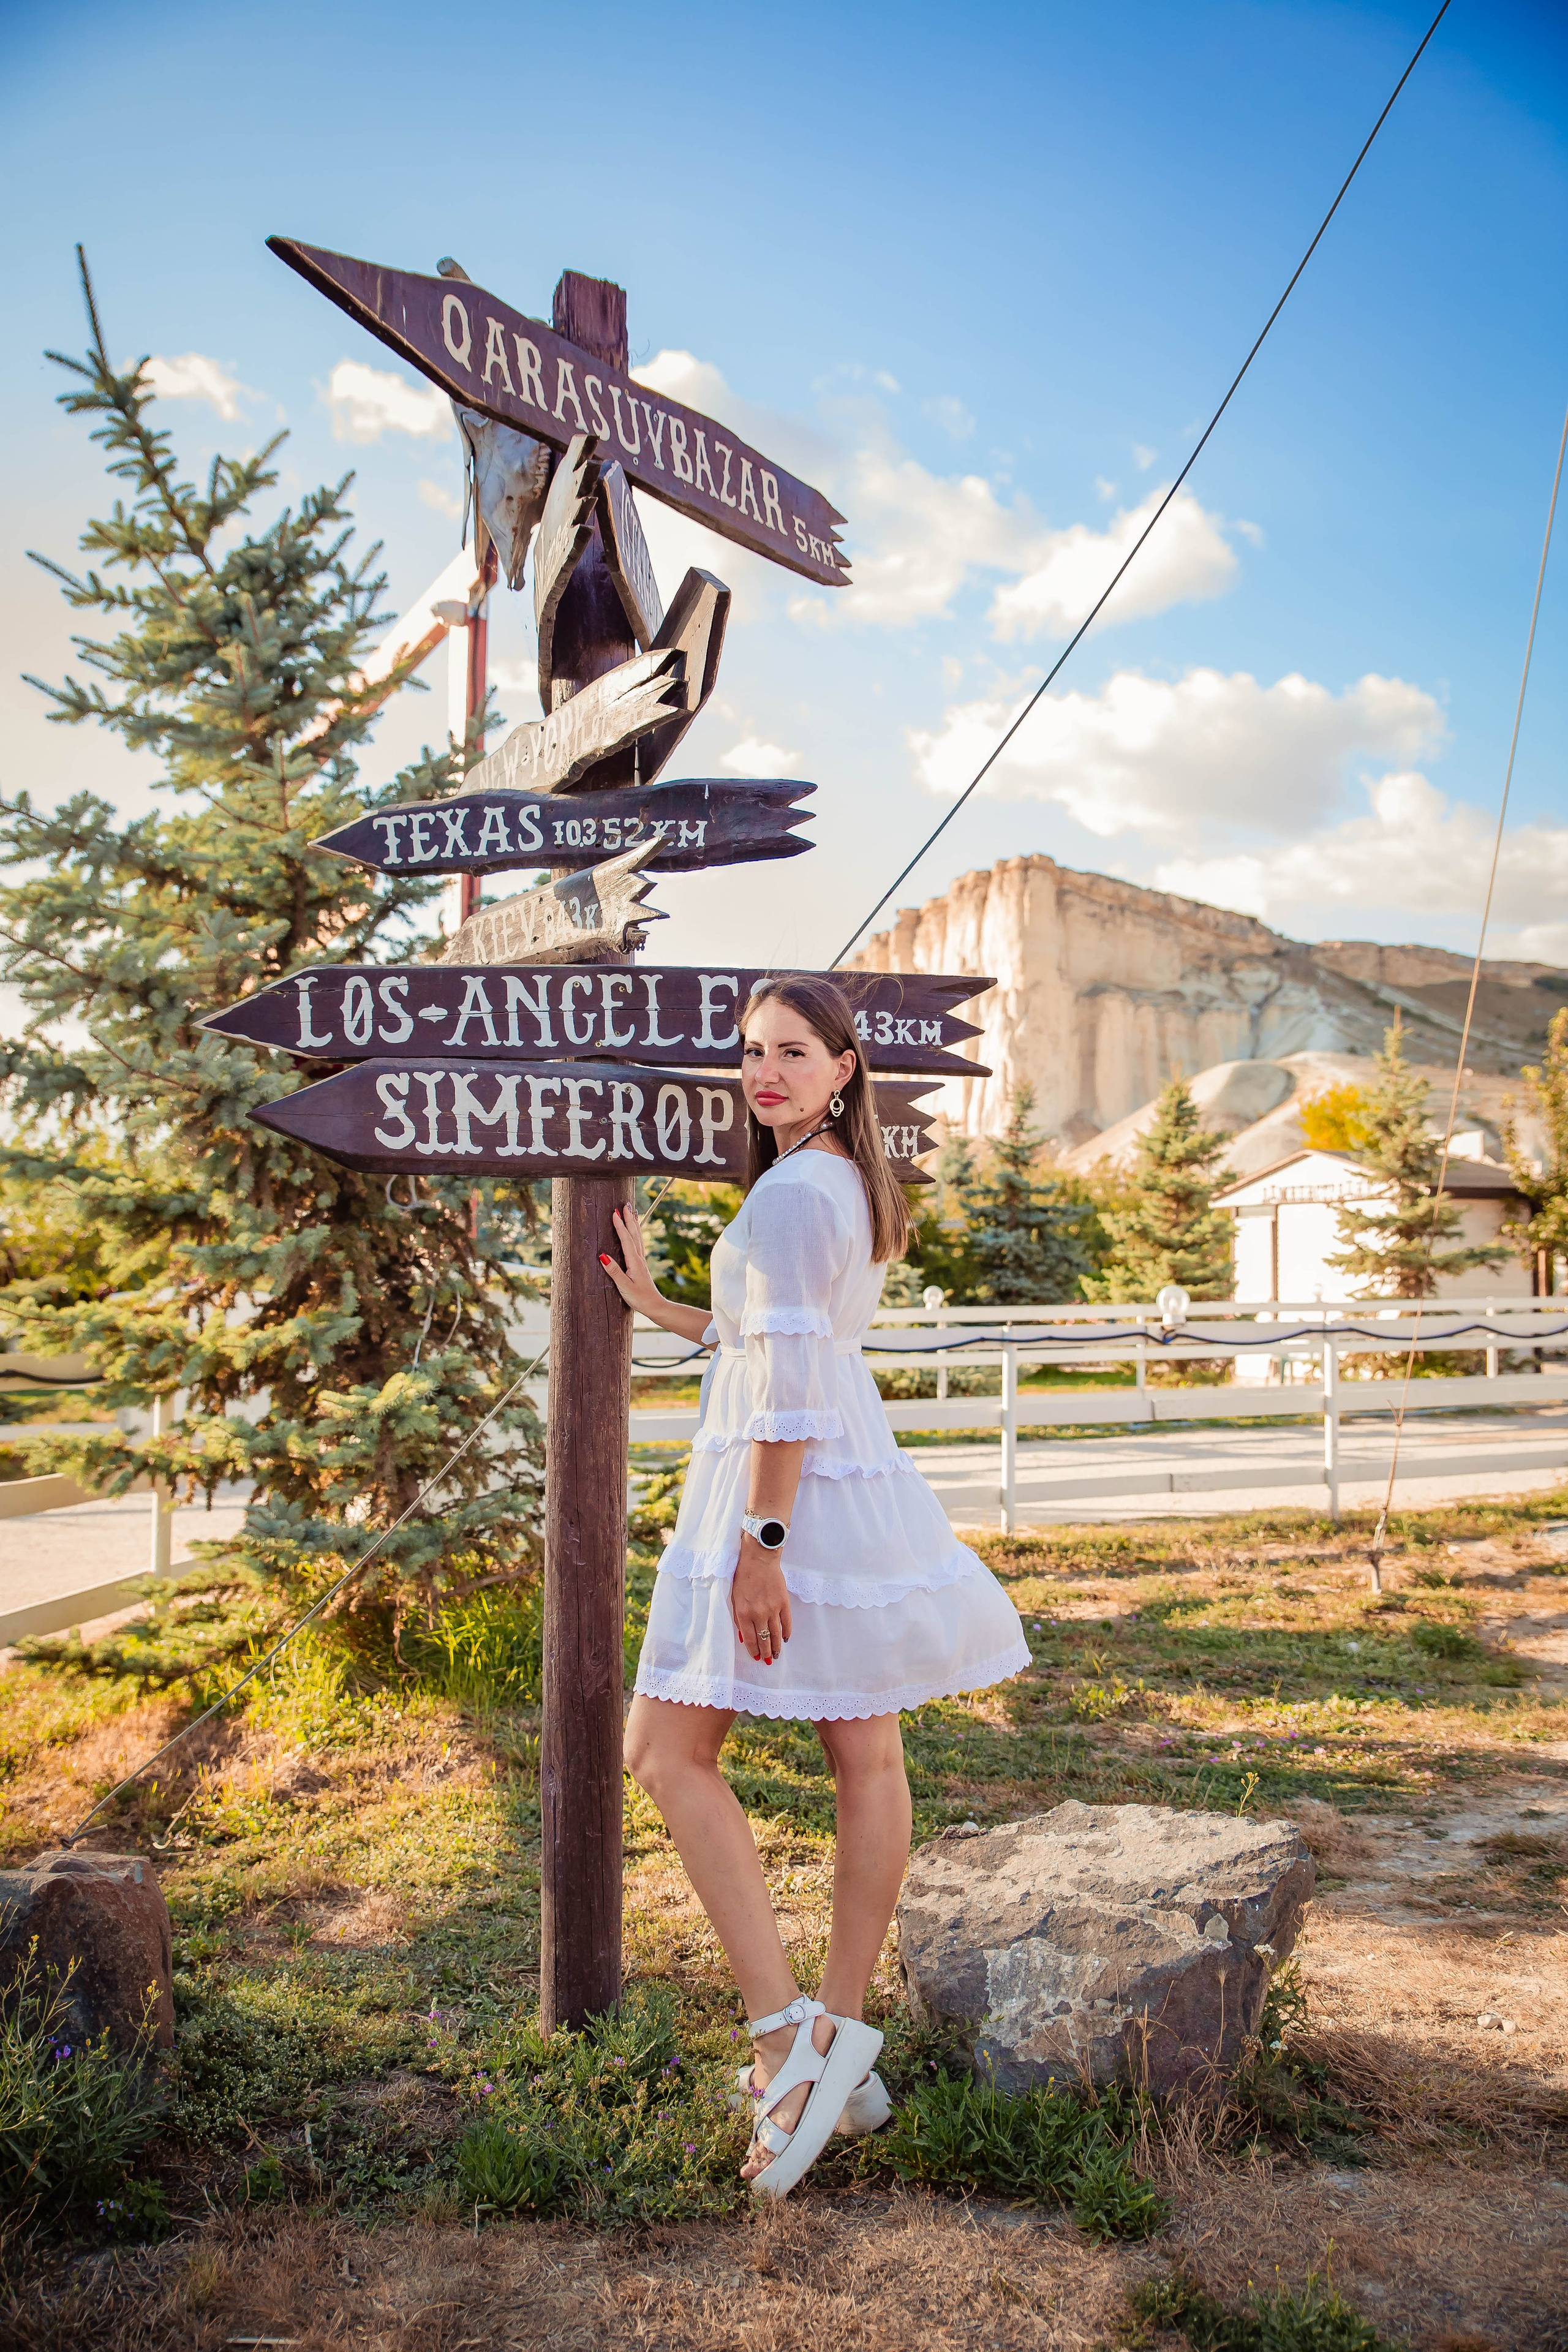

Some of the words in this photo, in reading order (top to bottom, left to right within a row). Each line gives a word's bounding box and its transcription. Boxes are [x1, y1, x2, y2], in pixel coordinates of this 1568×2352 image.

[793, 515, 836, 569] 5KM
[372, 804, 543, 864] TEXAS
[471, 899, 537, 964] KIEV
[293, 974, 775, 1049] LOS-ANGELE
[374, 1071, 751, 1164] SIMFEROP
